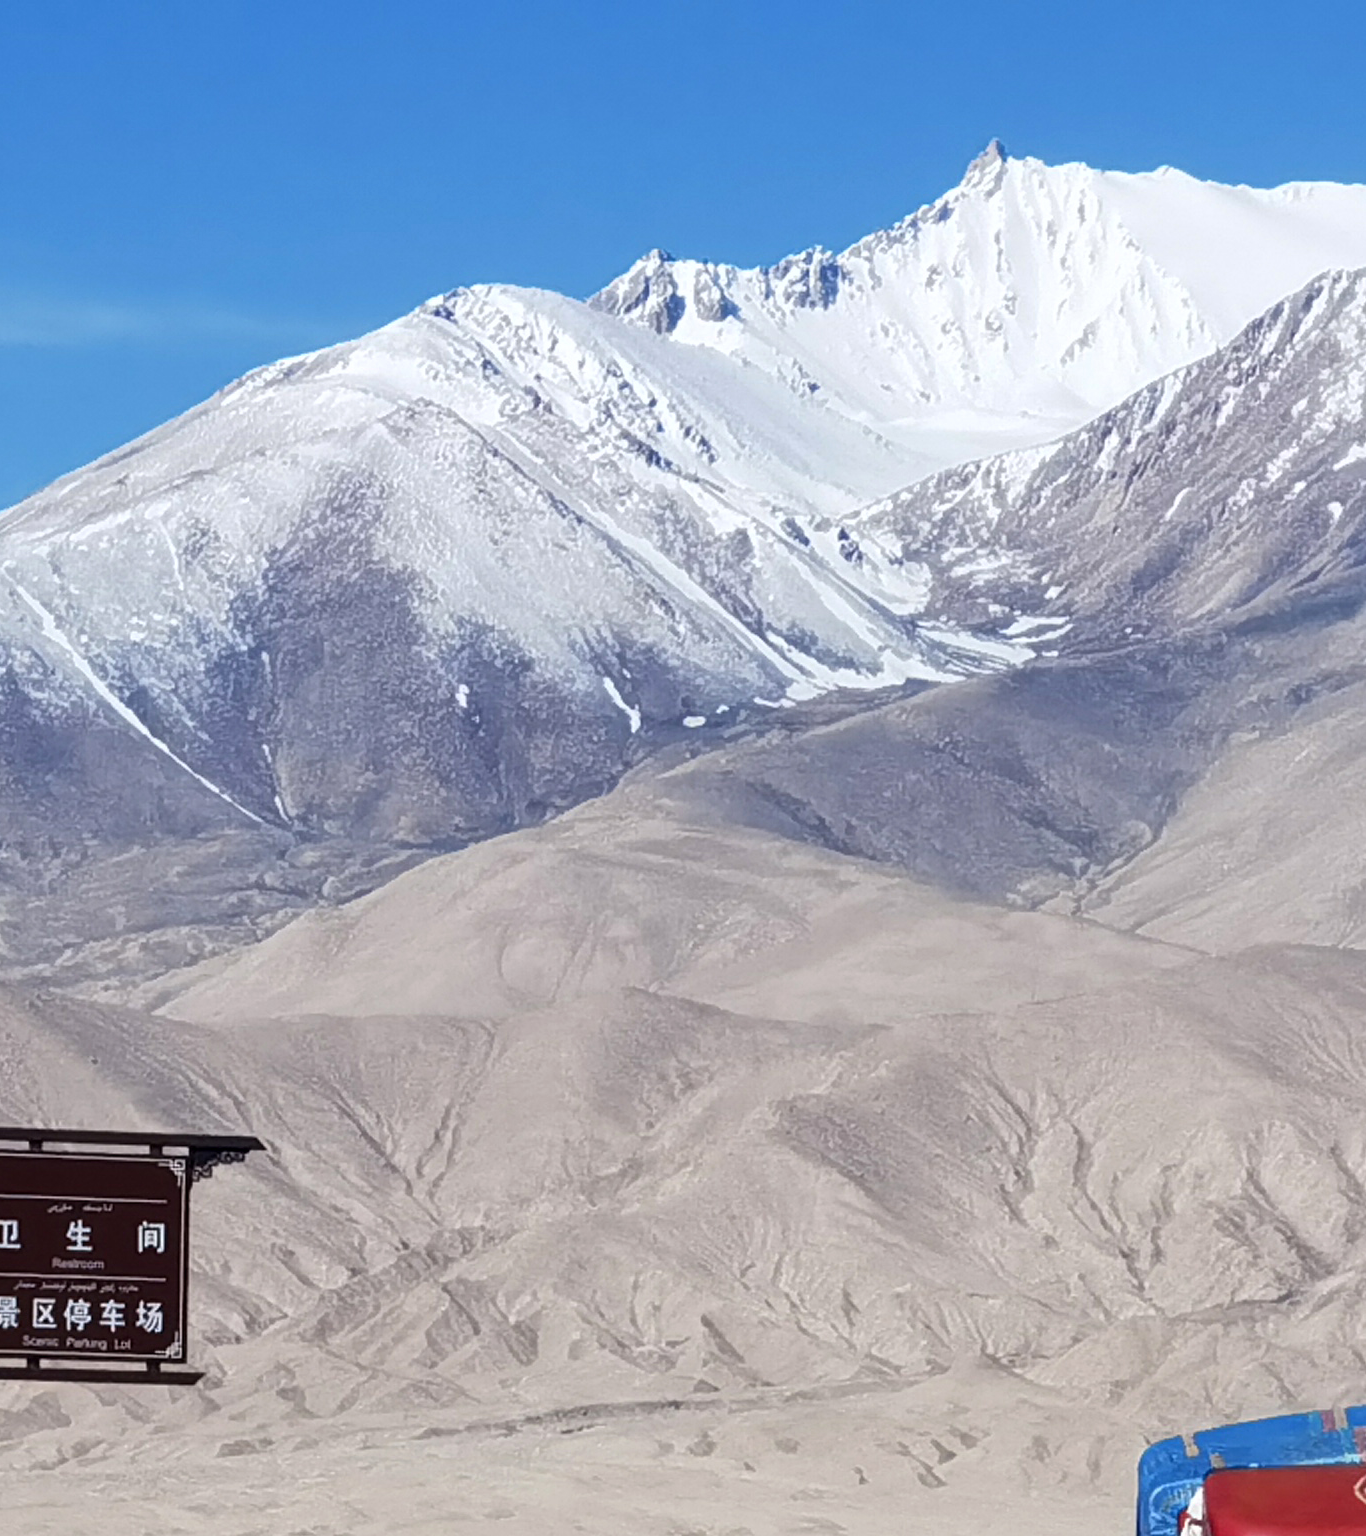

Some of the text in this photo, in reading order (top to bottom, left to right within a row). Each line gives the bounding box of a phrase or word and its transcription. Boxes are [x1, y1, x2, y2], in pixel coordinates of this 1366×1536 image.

[51, 1257, 105, 1270] Restroom
[22, 1334, 60, 1347] Scenic
[65, 1337, 108, 1351] Parking
